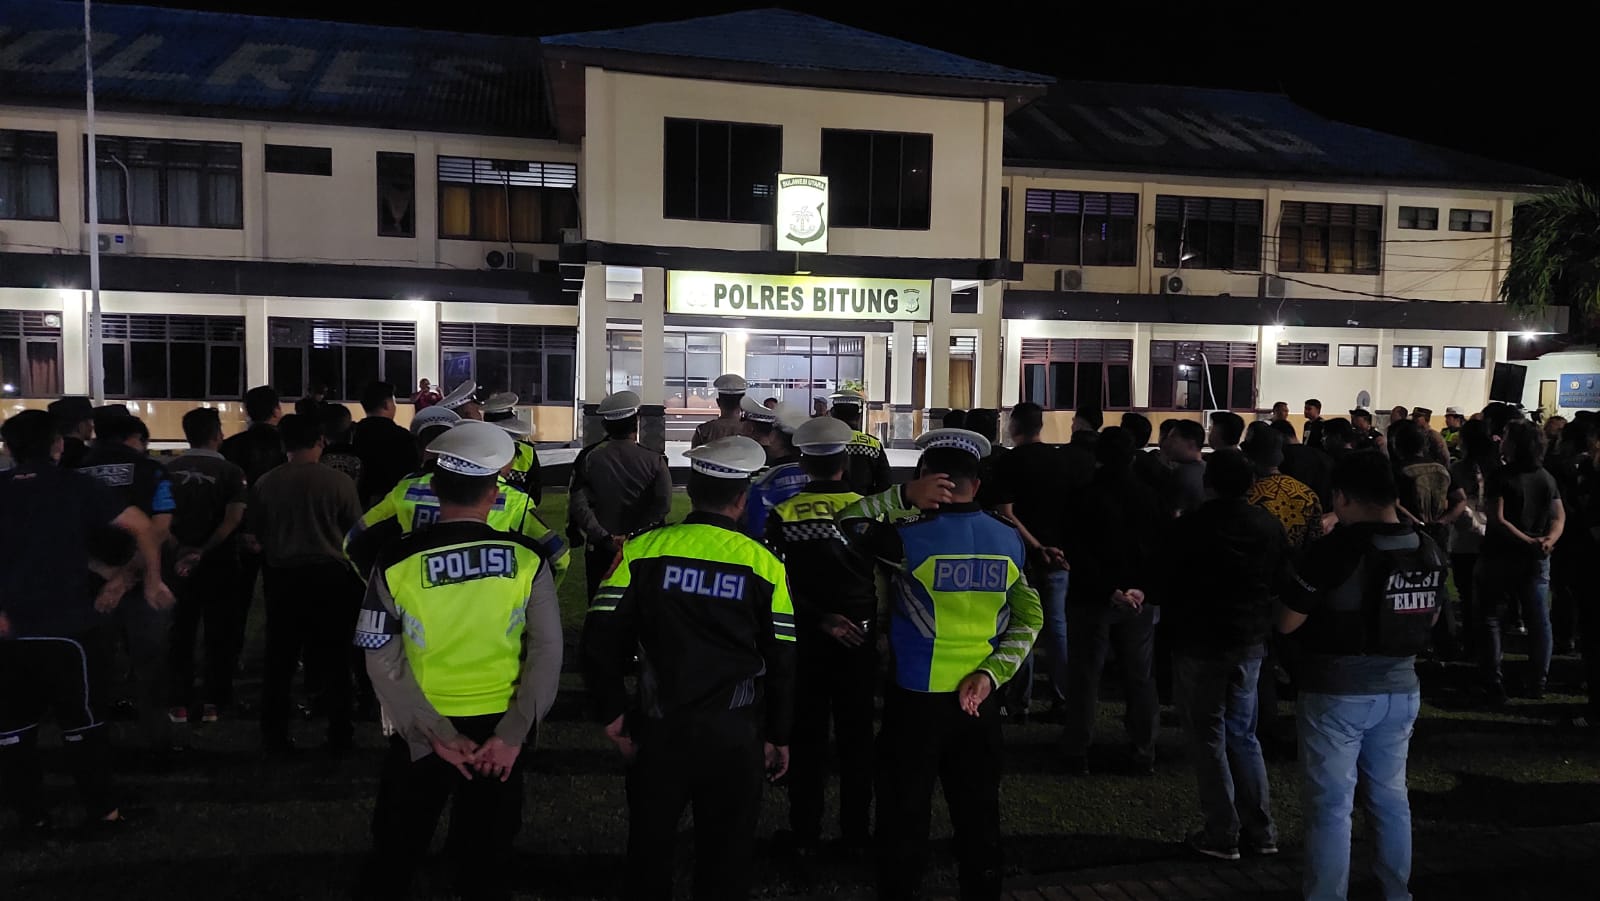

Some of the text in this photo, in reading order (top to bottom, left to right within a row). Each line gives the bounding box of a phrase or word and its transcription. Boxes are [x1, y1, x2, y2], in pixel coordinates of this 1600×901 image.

[714, 283, 898, 314] POLRES BITUNG
[427, 548, 513, 582] POLISI
[937, 562, 1007, 588] POLISI
[663, 565, 746, 600] POLISI
[1394, 591, 1436, 610] ELITE
